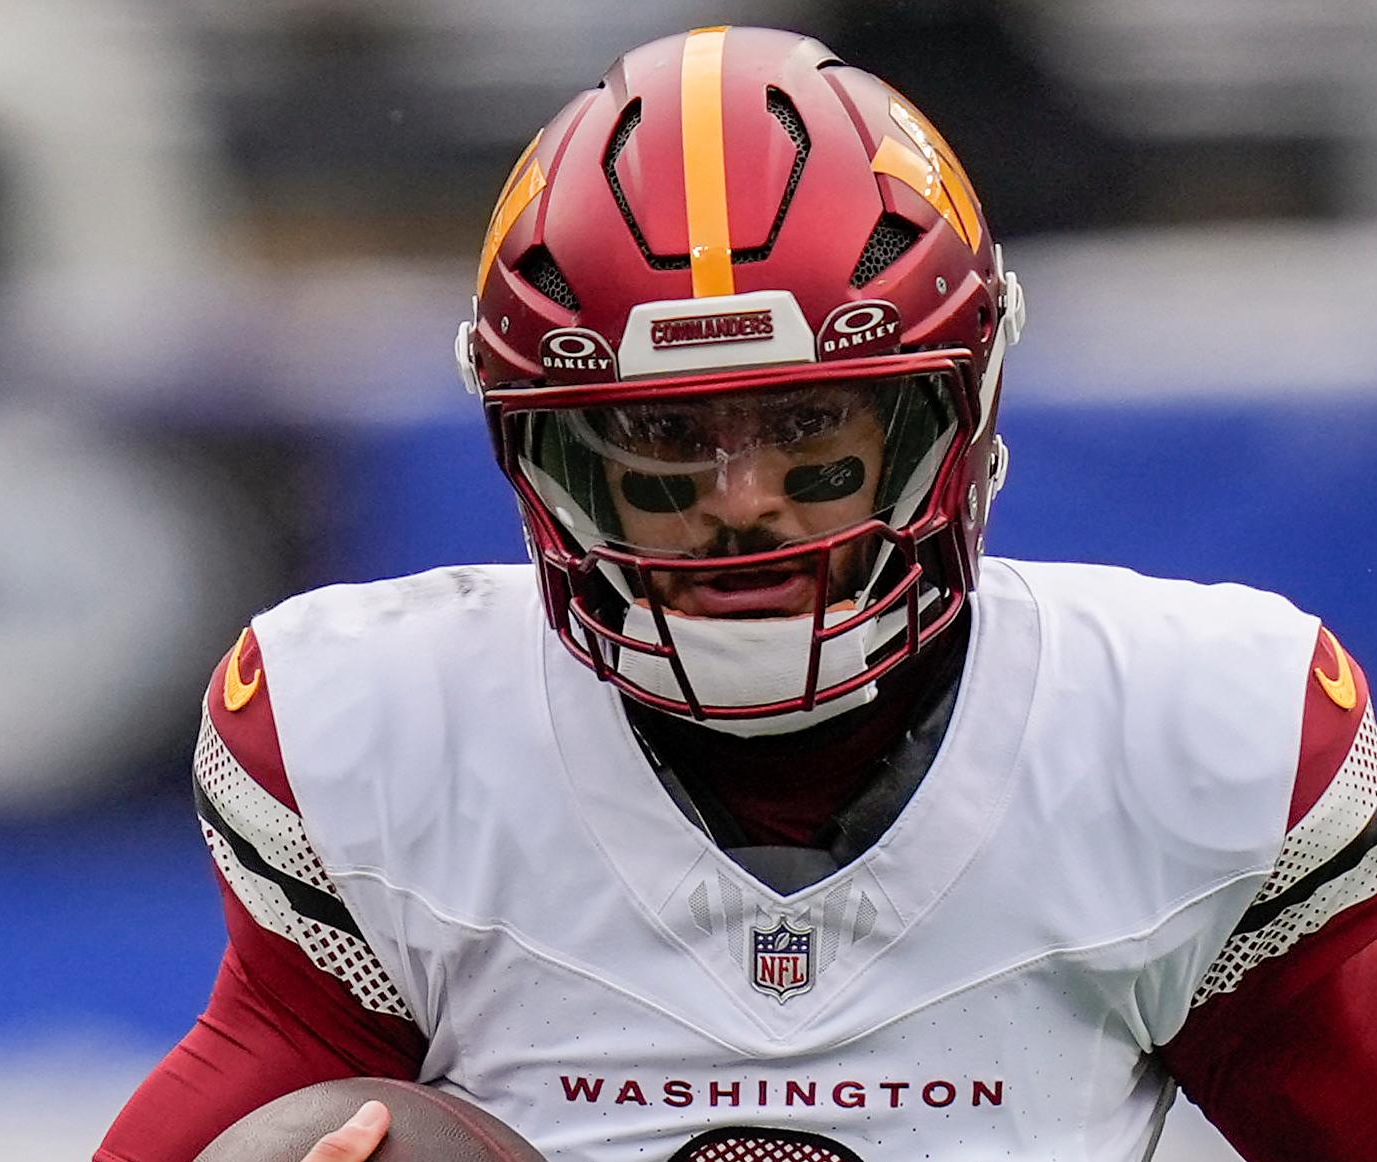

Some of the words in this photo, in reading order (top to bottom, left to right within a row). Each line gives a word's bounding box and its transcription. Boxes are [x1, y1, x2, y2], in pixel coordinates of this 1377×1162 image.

[650, 314, 775, 345] COMMANDERS
[824, 321, 900, 353] OAKLEY
[543, 356, 610, 370] OAKLEY
[759, 956, 805, 988] NFL
[560, 1076, 1005, 1108] WASHINGTON
